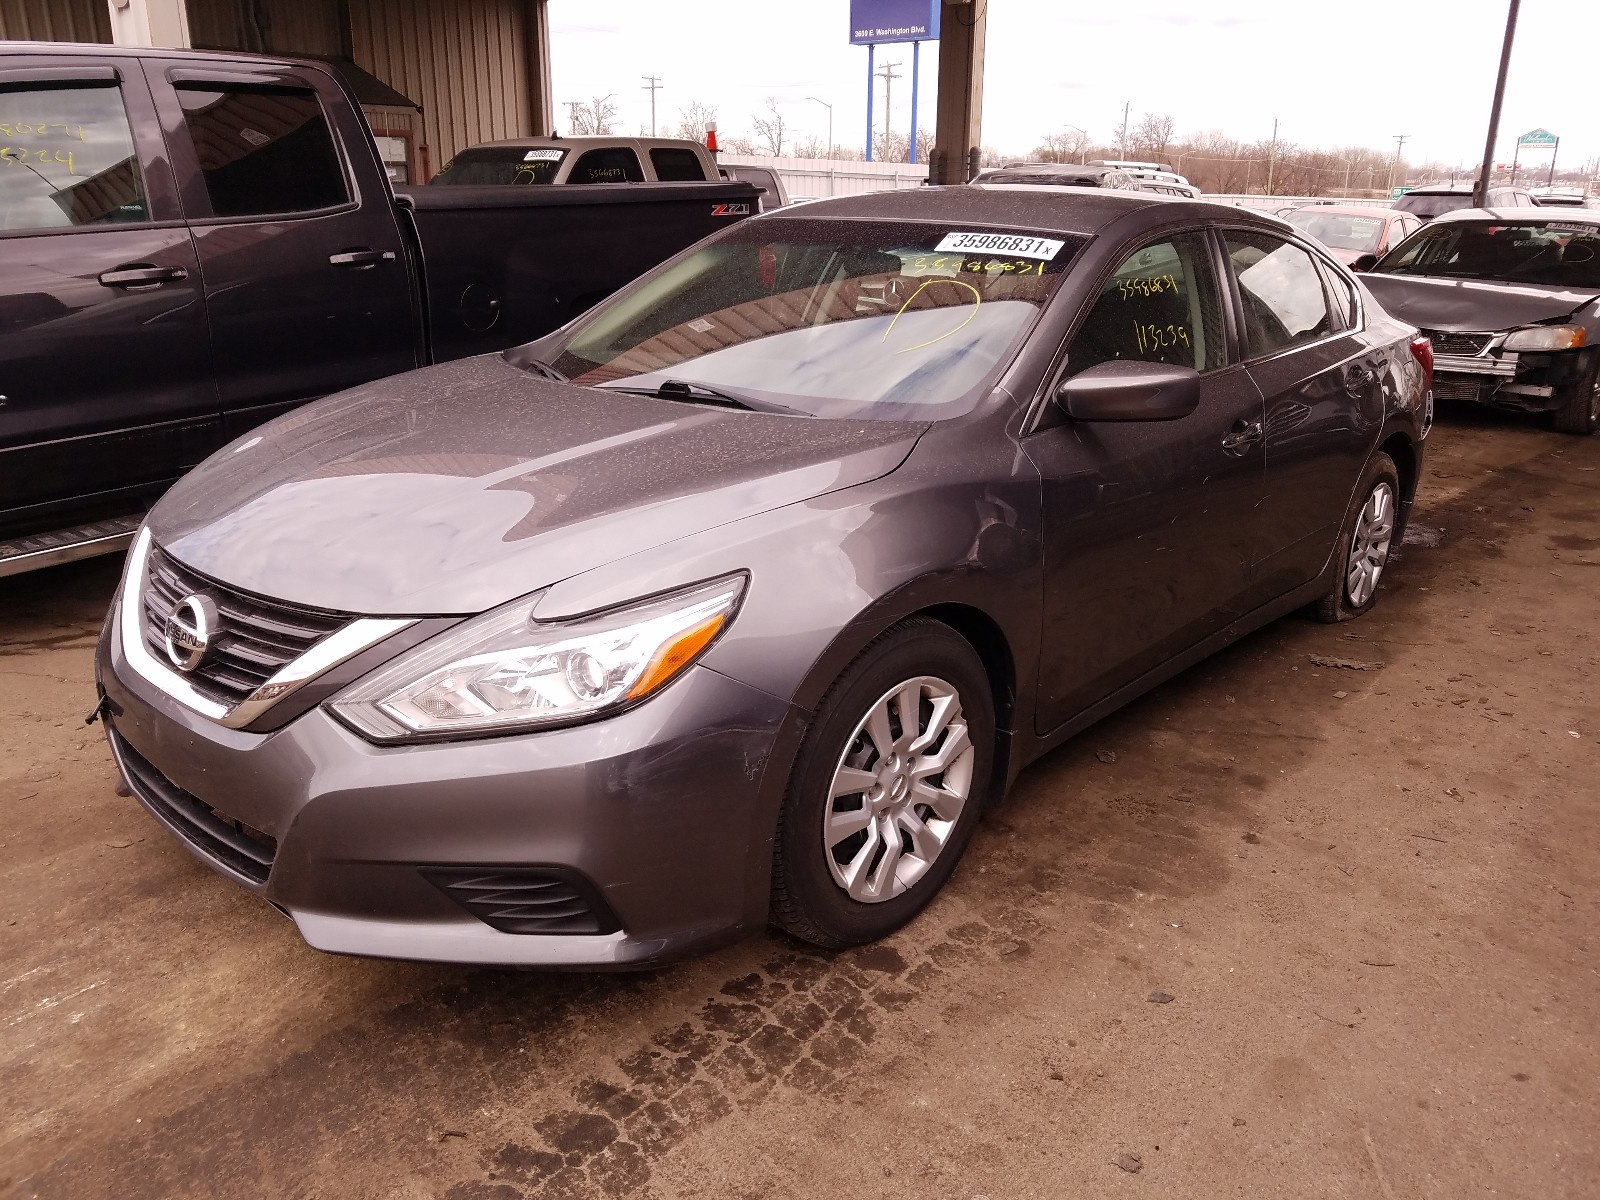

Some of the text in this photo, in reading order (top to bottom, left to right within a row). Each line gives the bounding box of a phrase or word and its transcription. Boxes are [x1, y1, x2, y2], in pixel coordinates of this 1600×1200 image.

[876, 26, 910, 36] Washington
[911, 25, 926, 34] Blvd.
[711, 203, 750, 216] Z71
[952, 234, 1046, 253] 35986831
[1132, 319, 1190, 354] 113239
